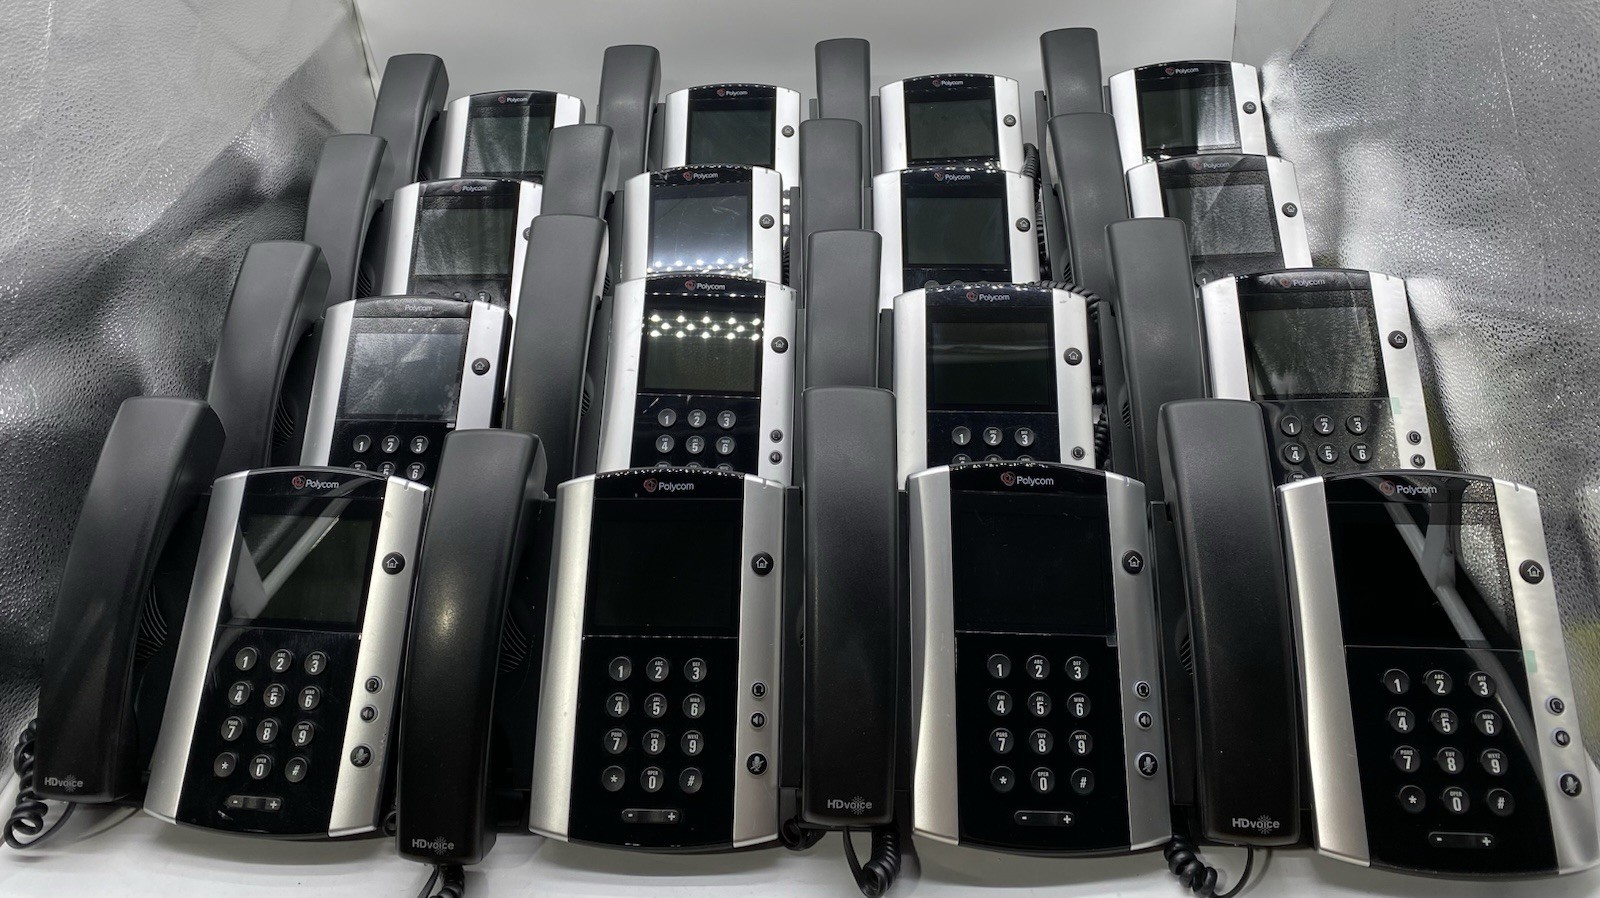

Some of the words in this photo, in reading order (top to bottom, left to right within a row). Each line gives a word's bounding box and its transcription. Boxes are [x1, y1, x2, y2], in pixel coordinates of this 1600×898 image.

[693, 172, 718, 181] Polycom
[944, 174, 970, 182] Polycom
[696, 283, 725, 291] Polycom
[1293, 279, 1326, 287] Polycom
[978, 294, 1010, 302] Polycom
[665, 416, 668, 424] 1
[694, 417, 700, 425] 2
[724, 418, 729, 426] 3
[1289, 423, 1294, 432] 1
[1322, 422, 1328, 431] 2
[1355, 422, 1361, 431] 3
[960, 434, 963, 443] 1
[990, 434, 996, 443] 2
[1022, 435, 1028, 444] 3
[360, 442, 363, 450] 1
[387, 442, 393, 451] 2
[416, 443, 422, 452] 3
[662, 442, 668, 450] 4
[692, 443, 698, 451] 5
[722, 444, 728, 452] 6
[1292, 451, 1299, 460] 4
[1326, 450, 1332, 459] 5
[1359, 450, 1366, 459] 6
[412, 470, 418, 478] 6
[305, 479, 339, 490] Polycom
[658, 482, 694, 492] Polycom
[1016, 476, 1053, 486] Polycom
[1396, 485, 1437, 496] Polycom
[242, 656, 249, 668] 1
[276, 658, 284, 670] 2
[311, 660, 319, 672] 3
[618, 666, 623, 677] 1
[655, 667, 662, 678] 2
[693, 667, 700, 679] 3
[997, 664, 1002, 676] 1
[1035, 665, 1043, 677] 2
[1074, 666, 1082, 678] 3
[1394, 678, 1401, 692] 1
[1436, 680, 1445, 693] 2
[1479, 682, 1488, 695] 3
[234, 691, 243, 703] 4
[270, 693, 278, 705] 5
[305, 695, 313, 707] 6
[615, 702, 622, 714] 4
[653, 702, 660, 715] 5
[691, 704, 698, 716] 6
[997, 701, 1006, 713] 4
[1037, 702, 1044, 714] 5
[1076, 703, 1083, 716] 6
[1399, 717, 1407, 730] 4
[1442, 718, 1450, 732] 5
[1485, 720, 1494, 734] 6
[228, 726, 235, 738] 7
[263, 728, 271, 740] 8
[299, 730, 307, 743] 9
[613, 738, 620, 750] 7
[651, 739, 658, 751] 8
[689, 740, 696, 752] 9
[998, 738, 1006, 751] 7
[1039, 739, 1045, 752] 8
[1078, 740, 1085, 753] 9
[1403, 756, 1410, 769] 7
[1448, 758, 1456, 771] 8
[1491, 759, 1500, 773] 9
[256, 763, 264, 776] 0
[292, 765, 300, 776] #
[649, 776, 656, 788] 0
[687, 776, 695, 786] #
[1040, 777, 1047, 790] 0
[1080, 777, 1087, 788] #
[1453, 797, 1461, 811] 0
[1497, 797, 1504, 809] #
